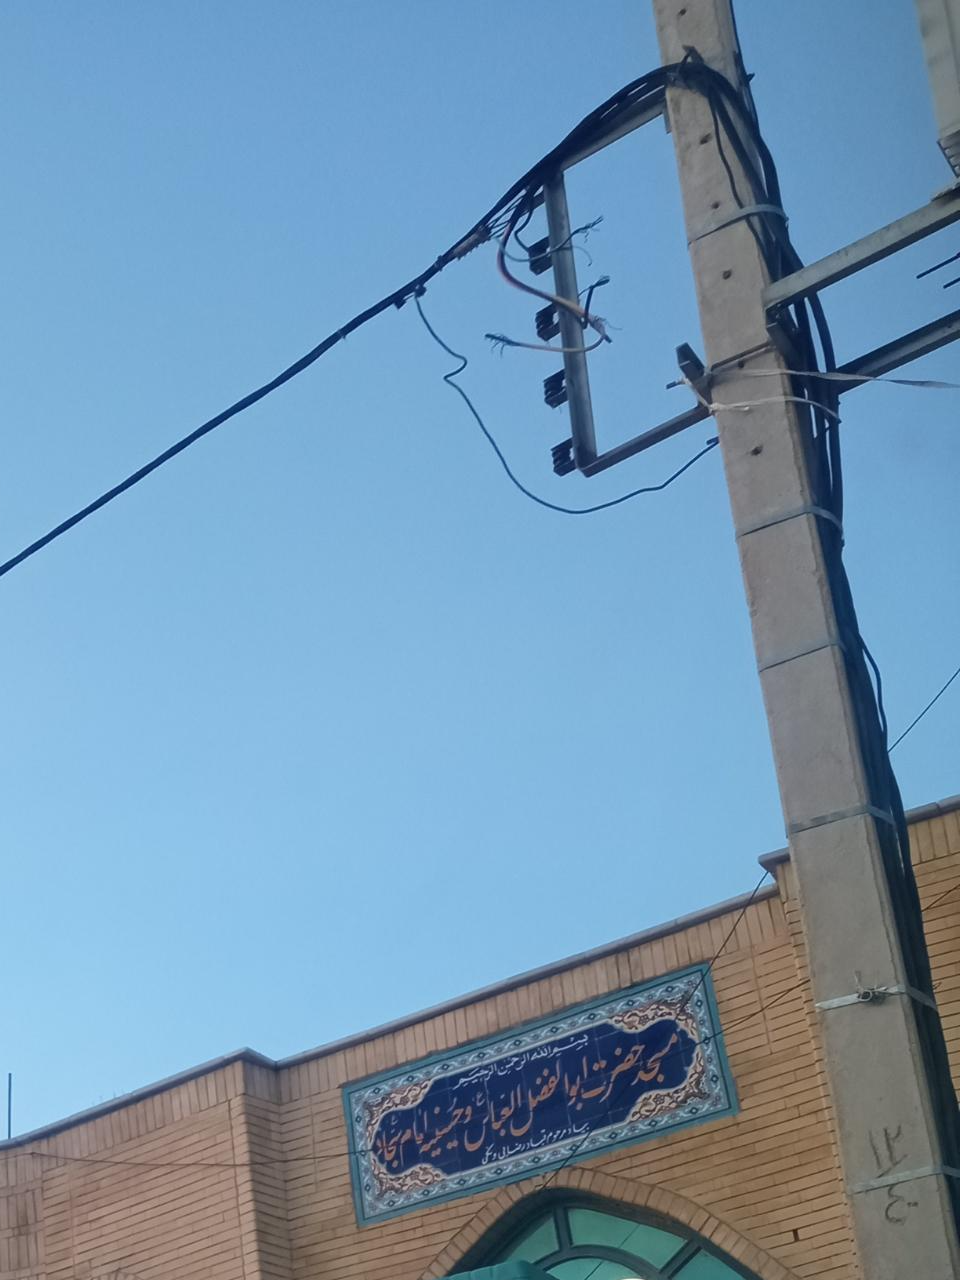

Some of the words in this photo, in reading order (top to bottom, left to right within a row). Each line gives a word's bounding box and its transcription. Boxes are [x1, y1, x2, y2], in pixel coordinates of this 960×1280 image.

[581, 1044, 646, 1103] حضرت
[631, 1033, 678, 1087] مسجد
[400, 1109, 428, 1167] امام
